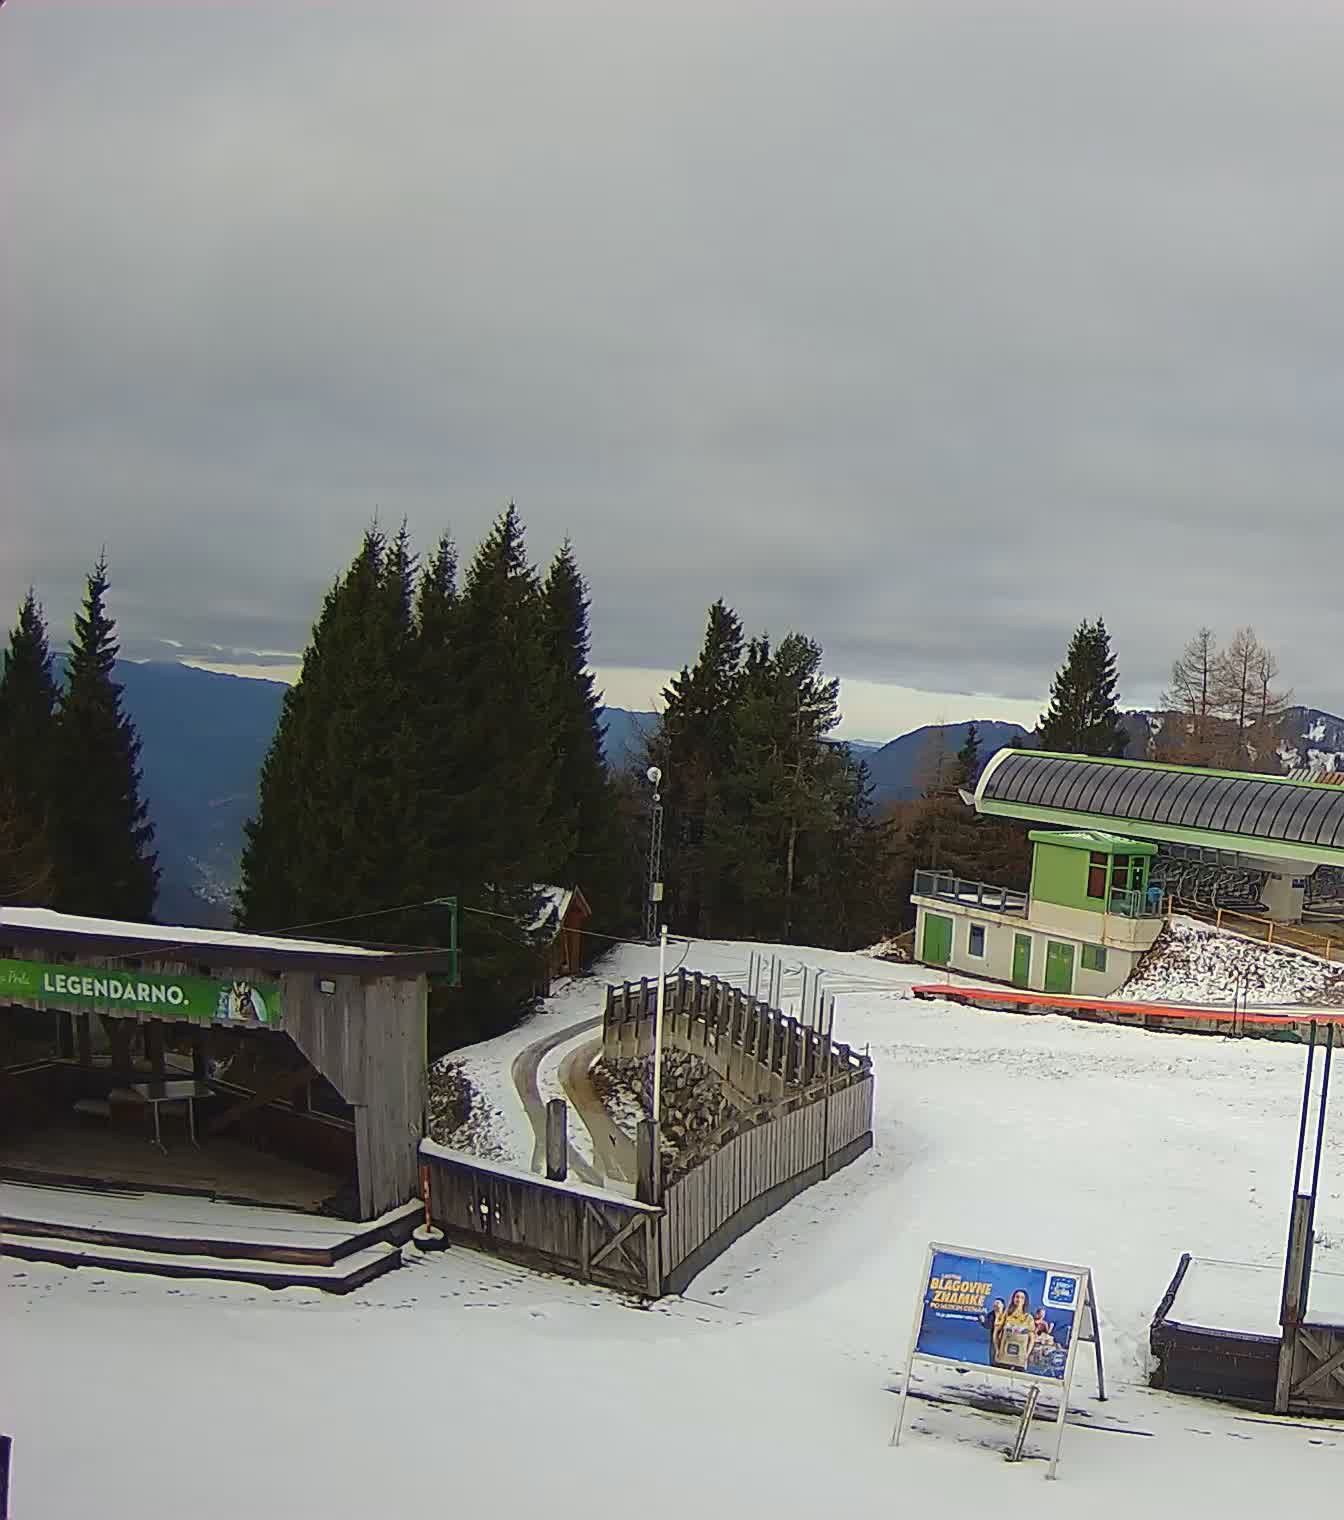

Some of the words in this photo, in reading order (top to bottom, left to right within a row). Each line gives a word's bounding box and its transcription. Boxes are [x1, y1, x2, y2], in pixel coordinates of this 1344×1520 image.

[44, 973, 189, 1005] LEGENDARNO.
[931, 1278, 992, 1295] BLAGOVNE
[933, 1291, 985, 1306] ZNAMKE
